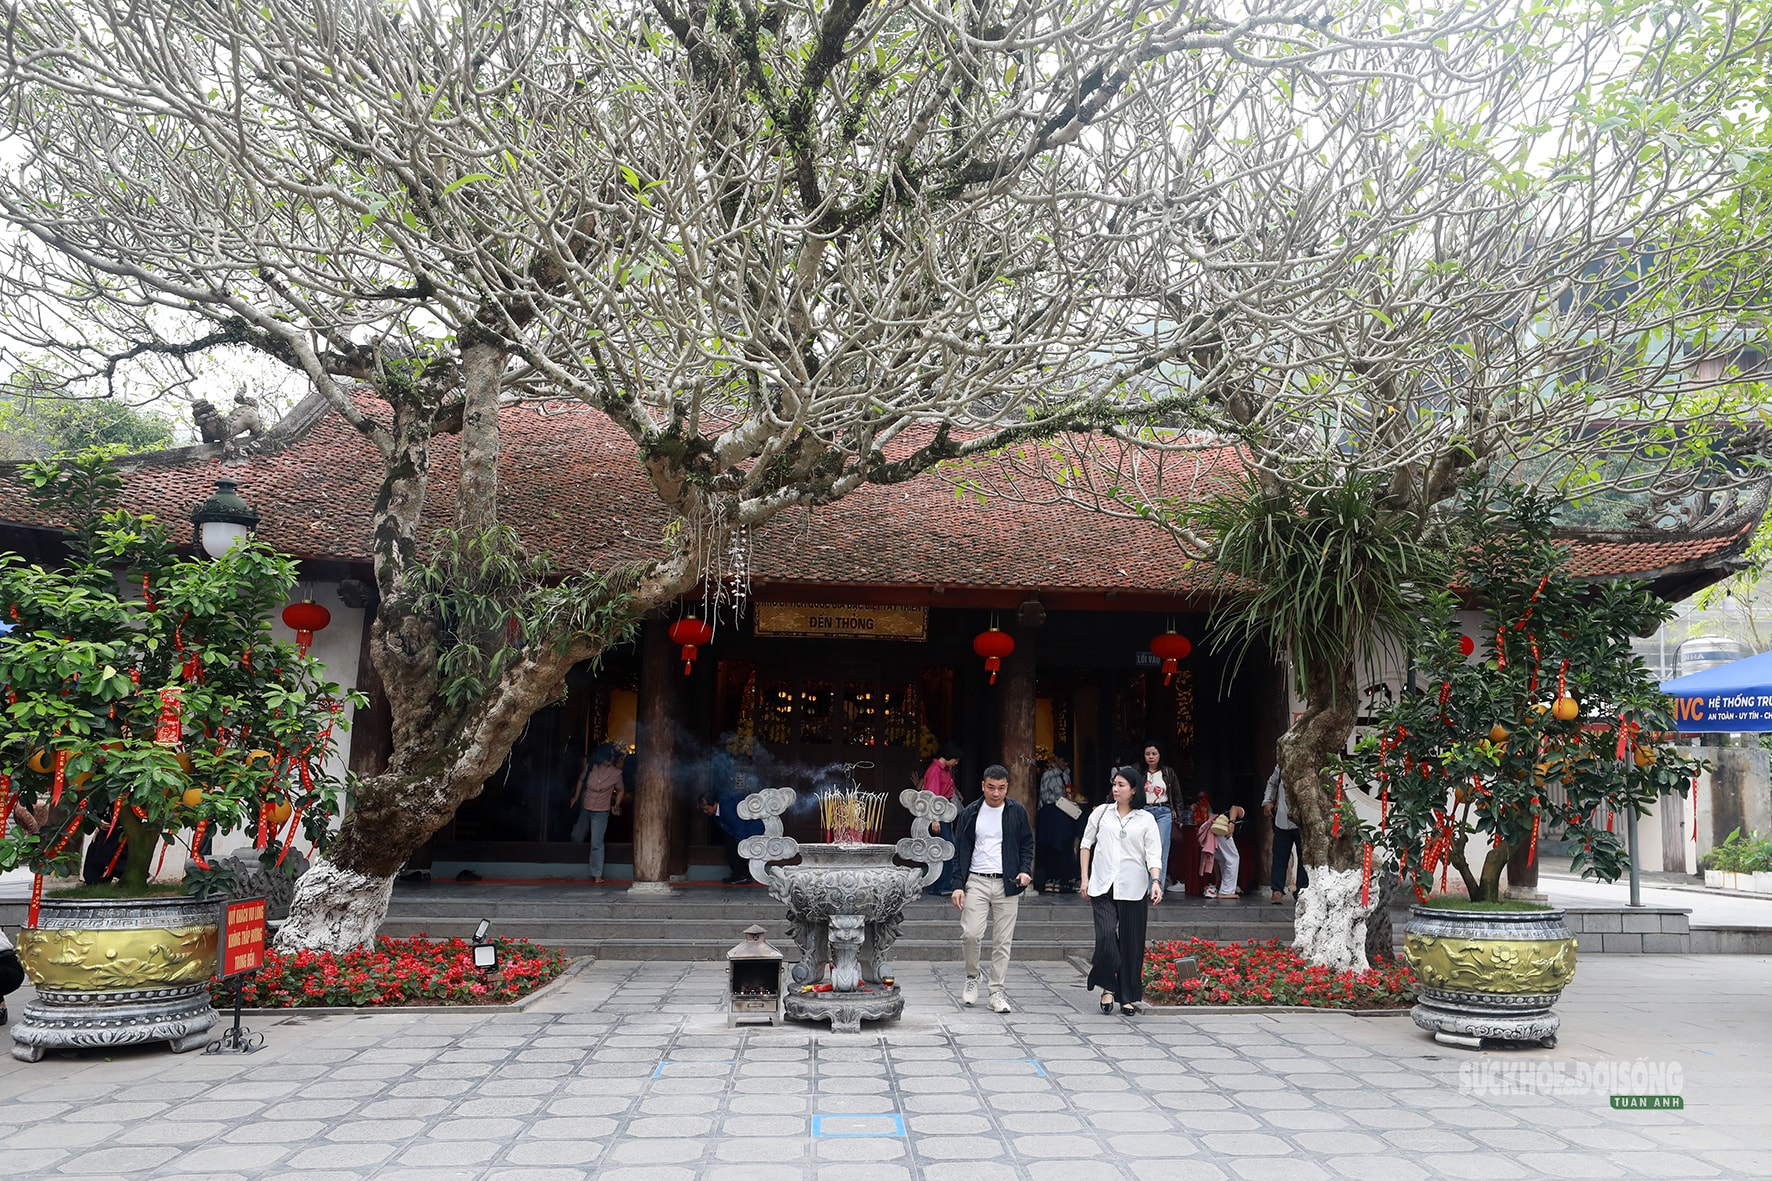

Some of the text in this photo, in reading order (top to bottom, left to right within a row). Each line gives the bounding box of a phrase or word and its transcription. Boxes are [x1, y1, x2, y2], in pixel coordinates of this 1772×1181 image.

[1708, 695, 1721, 711] HỆ
[1723, 693, 1755, 708] THỐNG
[1708, 713, 1717, 721] AN
[1718, 711, 1735, 720] TOÀN
[1739, 712, 1748, 720] UY
[1749, 710, 1759, 720] TÍN
